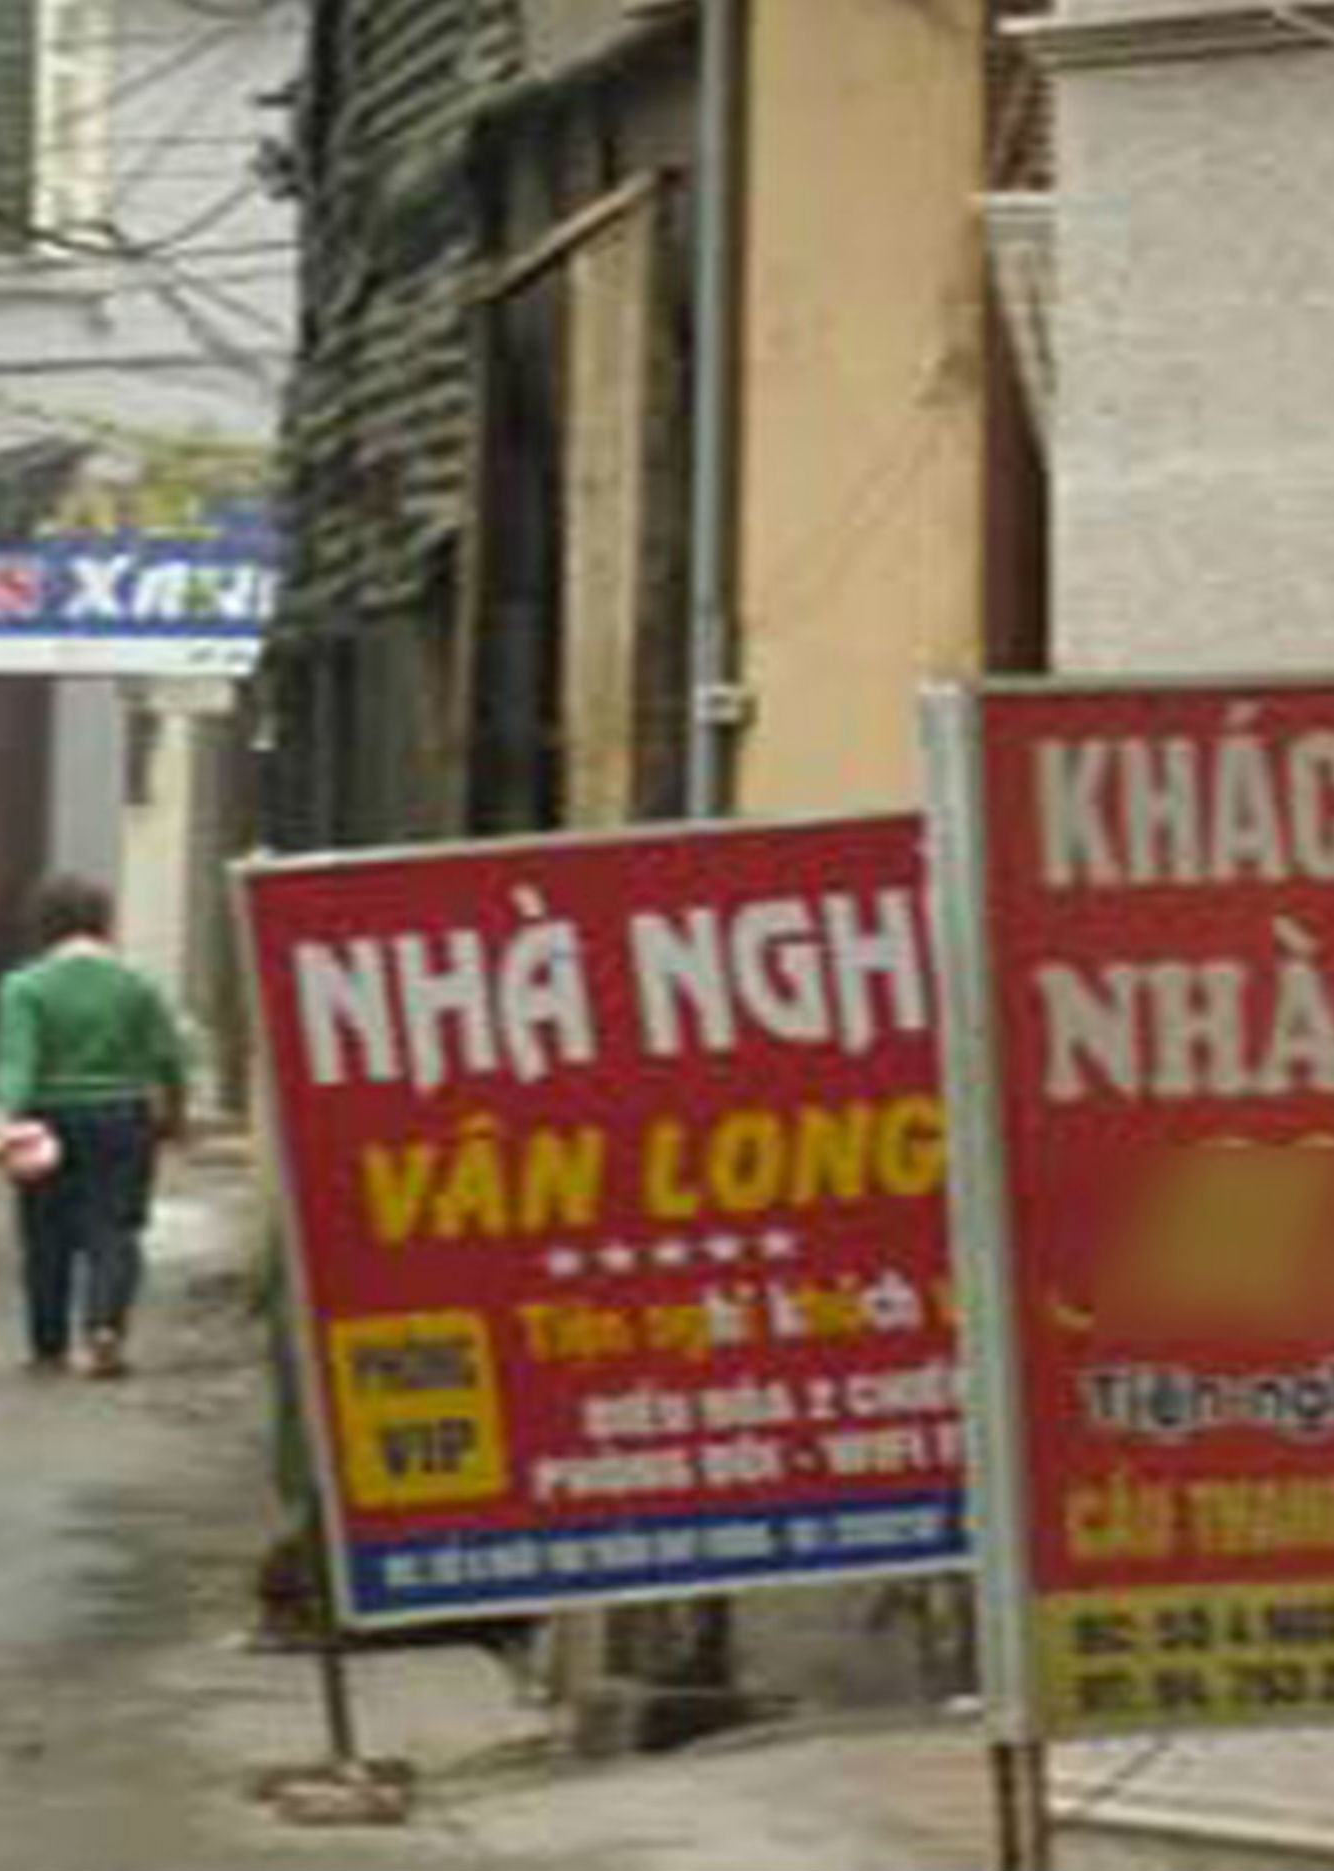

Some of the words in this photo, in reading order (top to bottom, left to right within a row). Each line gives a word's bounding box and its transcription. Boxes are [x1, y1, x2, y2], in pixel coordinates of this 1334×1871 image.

[292, 885, 597, 1094] NHÀ
[627, 886, 931, 1056] NGH
[361, 1113, 607, 1243] VÂN
[642, 1092, 951, 1225] LONG
[379, 1416, 481, 1478] VIP
